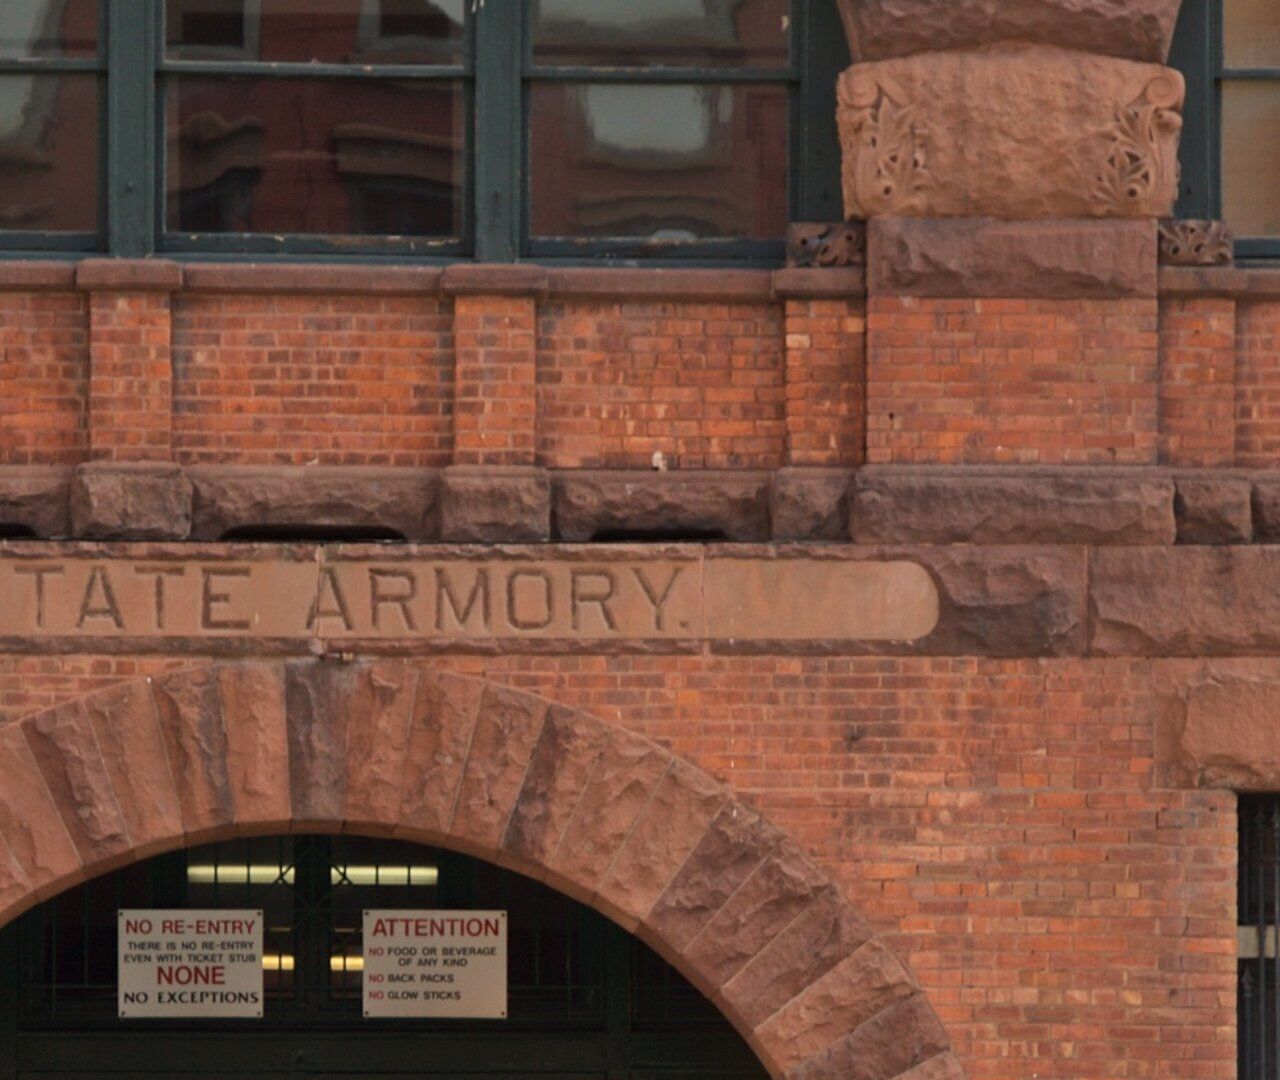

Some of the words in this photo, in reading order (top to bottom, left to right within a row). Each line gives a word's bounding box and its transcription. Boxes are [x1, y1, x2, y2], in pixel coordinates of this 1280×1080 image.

[125, 919, 153, 935] NO
[161, 919, 255, 935] RE-ENTRY
[372, 917, 500, 937] ATTENTION
[128, 941, 161, 951] THERE
[166, 941, 176, 951] IS
[181, 941, 197, 951] NO
[201, 941, 254, 951] RE-ENTRY
[368, 947, 384, 957] NO
[387, 946, 417, 956] FOOD
[421, 946, 437, 956] OR
[441, 946, 497, 956] BEVERAGE
[123, 953, 152, 963] EVEN
[156, 953, 182, 963] WITH
[188, 953, 222, 963] TICKET
[228, 953, 256, 963] STUB
[398, 958, 411, 967] OF
[417, 957, 438, 967] ANY
[442, 957, 468, 967] KIND
[156, 964, 226, 986] NONE
[368, 974, 385, 984] NO
[387, 974, 416, 984] BACK
[420, 973, 455, 984] PACKS
[123, 991, 148, 1004] NO
[157, 991, 260, 1004] EXCEPTIONS
[368, 991, 385, 1000] NO
[387, 990, 419, 1000] GLOW
[423, 990, 462, 1000] STICKS
